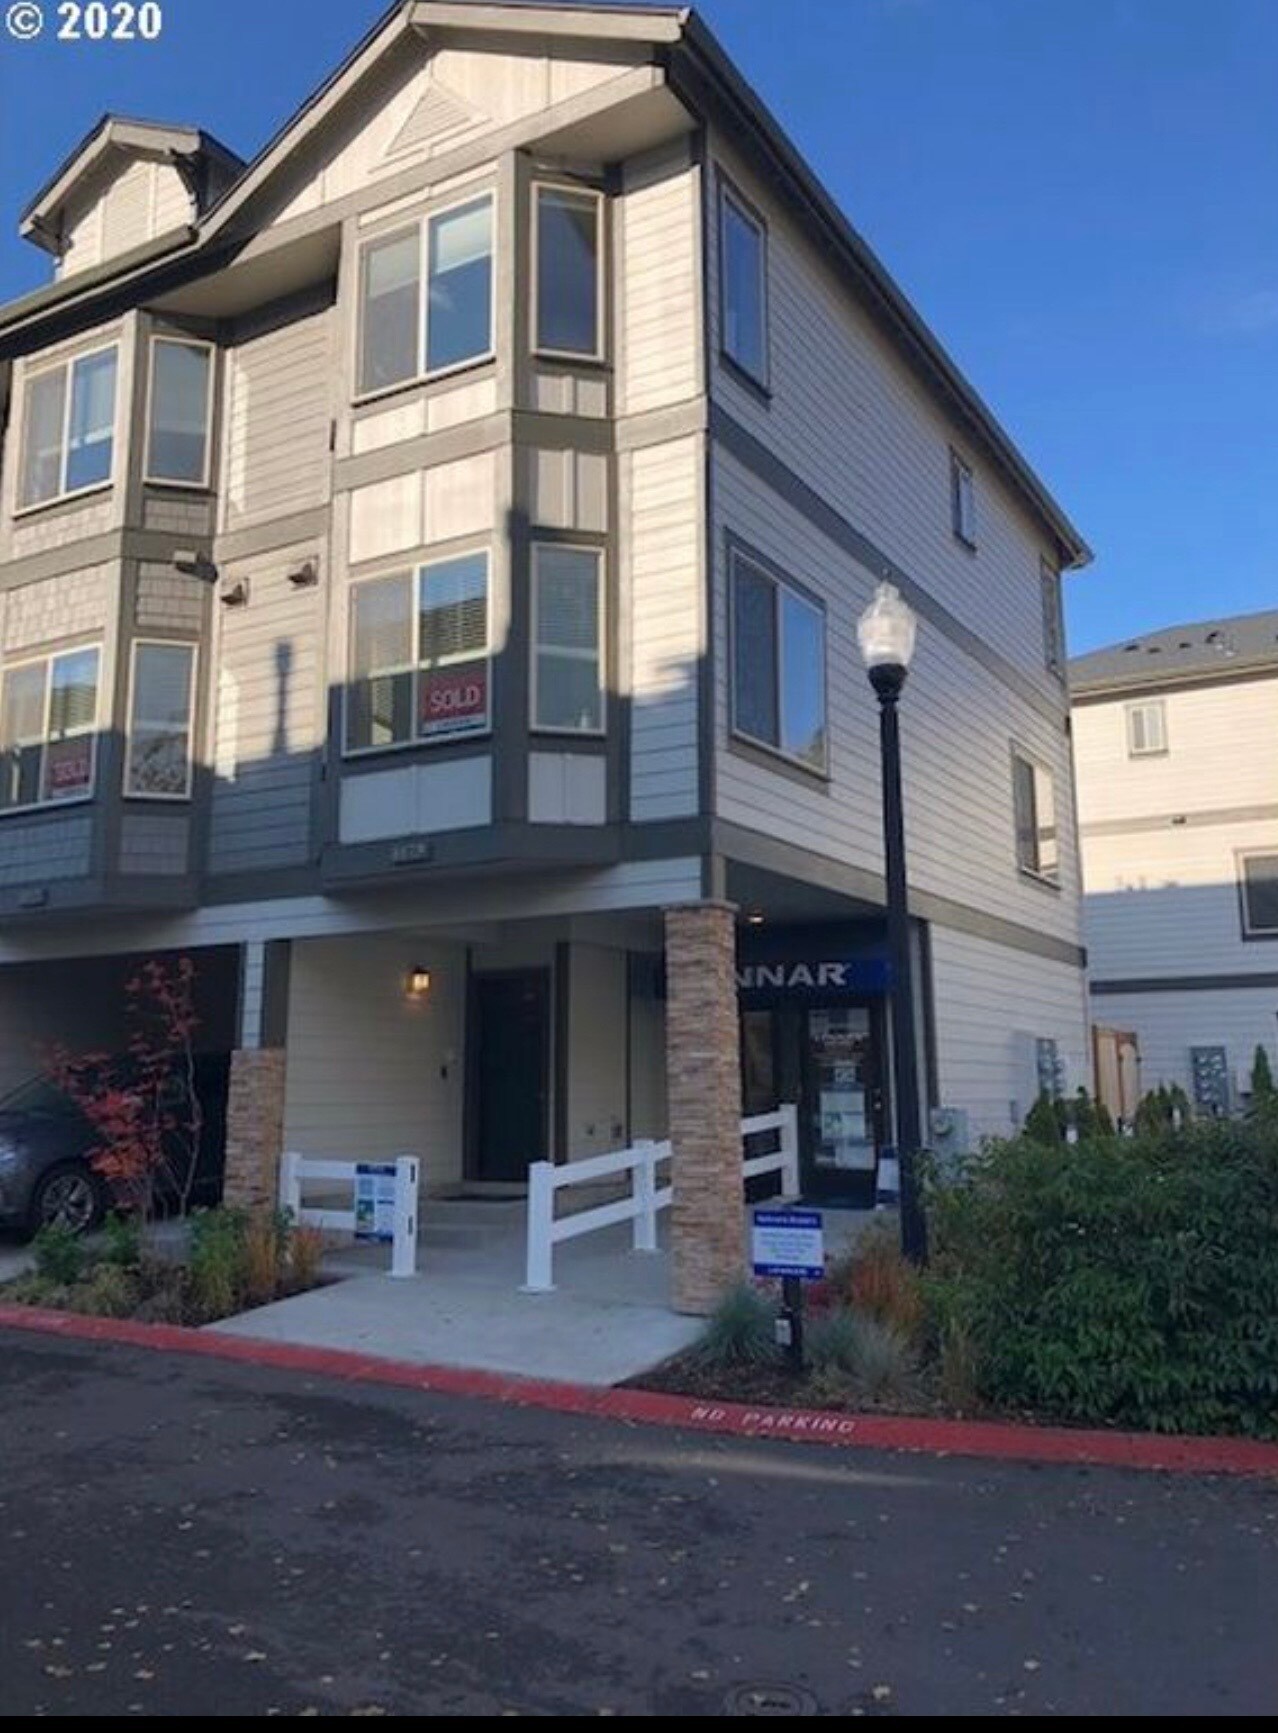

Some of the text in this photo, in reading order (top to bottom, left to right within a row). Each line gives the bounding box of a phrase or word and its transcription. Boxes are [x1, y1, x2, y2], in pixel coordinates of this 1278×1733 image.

[430, 686, 480, 711] SOLD
[690, 1407, 855, 1433] NO PARKING
